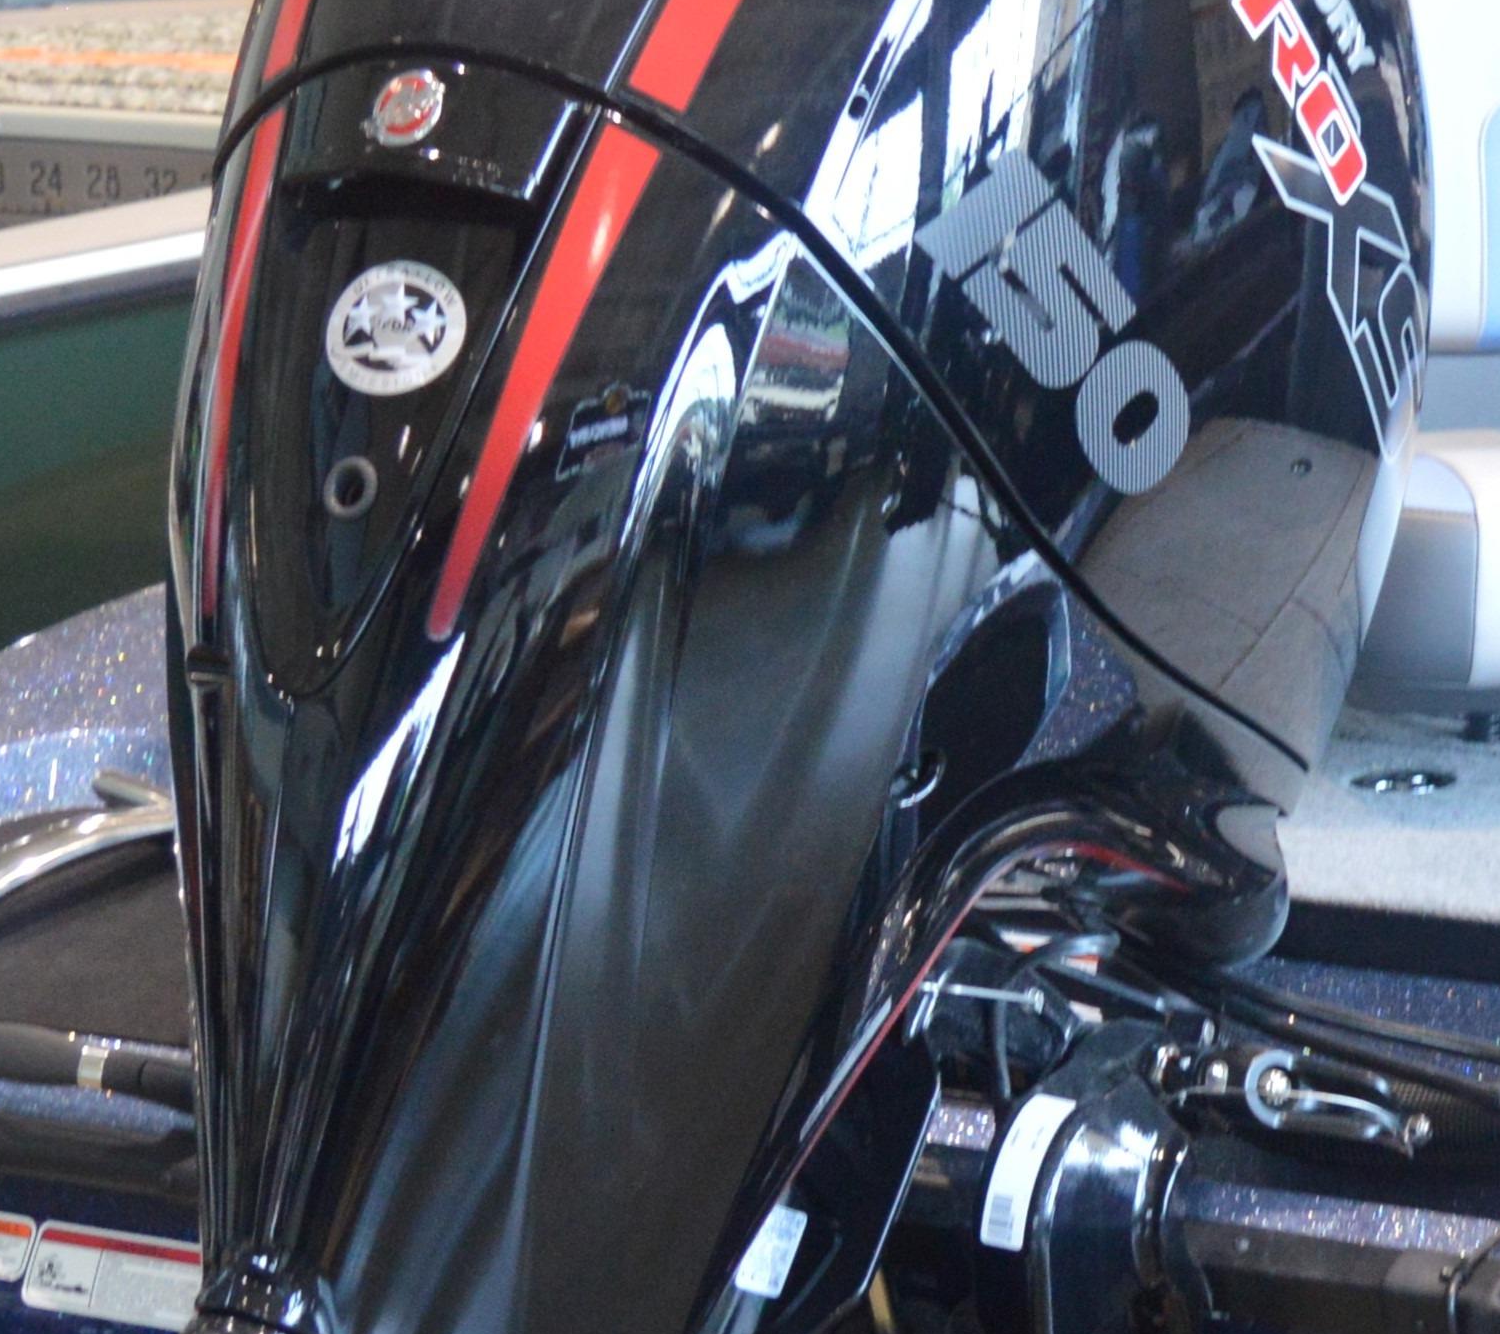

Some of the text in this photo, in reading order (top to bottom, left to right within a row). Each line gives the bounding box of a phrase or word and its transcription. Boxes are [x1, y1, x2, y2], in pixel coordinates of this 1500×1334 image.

[30, 160, 63, 198] 24
[87, 163, 121, 200] 28
[914, 149, 1191, 496] 150
